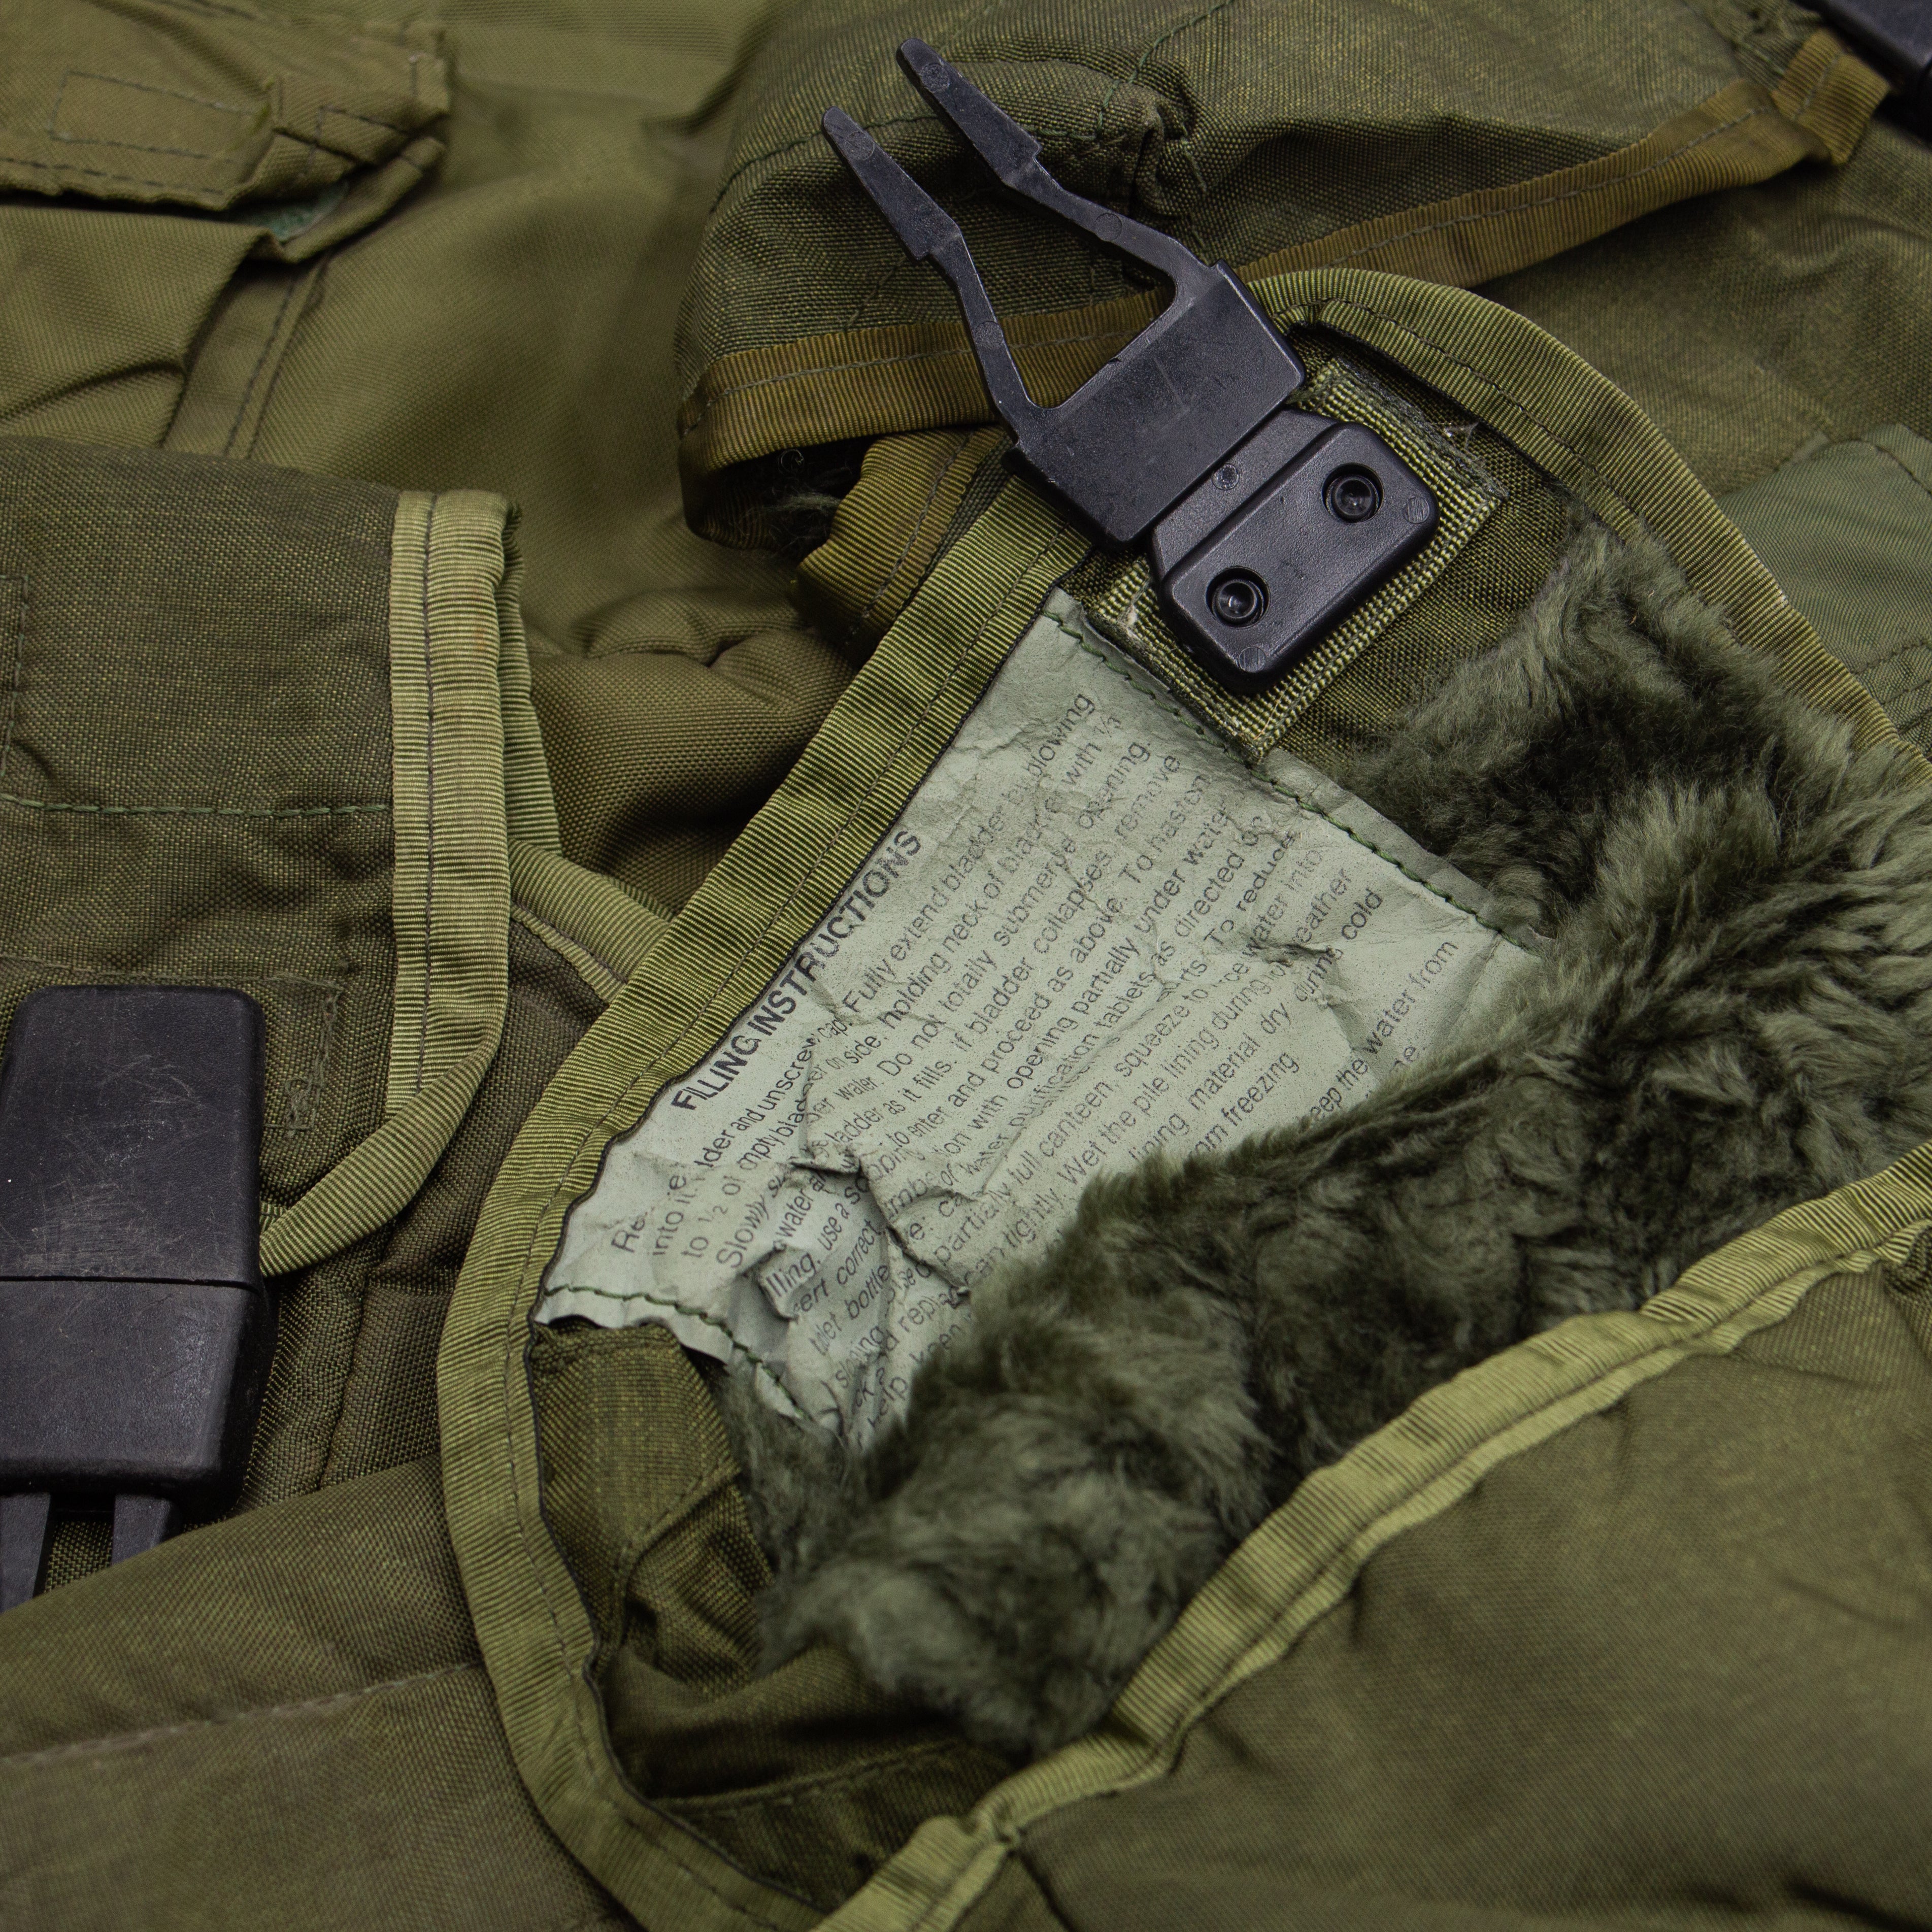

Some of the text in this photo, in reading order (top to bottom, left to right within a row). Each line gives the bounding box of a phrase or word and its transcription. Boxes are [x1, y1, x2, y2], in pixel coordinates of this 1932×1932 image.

[652, 1211, 684, 1256] into
[825, 1054, 846, 1070] on
[876, 952, 951, 1029] holding
[942, 900, 988, 953] neck
[976, 868, 1009, 899] of
[1061, 743, 1102, 785] with
[671, 1036, 762, 1110] FILLING
[748, 831, 921, 1036] INSTRUCTIONS
[716, 1195, 769, 1268] Slowly
[824, 1107, 883, 1142] ladder
[883, 1094, 906, 1119] as
[897, 1084, 922, 1101] it
[912, 1060, 957, 1089] fills.
[964, 957, 1034, 1035] bladder
[1114, 755, 1180, 839] remove
[730, 1108, 766, 1131] and
[842, 958, 893, 1013] Fully
[890, 886, 949, 961] extend
[1023, 693, 1096, 778] blowing
[777, 1188, 812, 1237] water
[907, 1106, 949, 1137] enter
[949, 1071, 986, 1108] and
[980, 992, 1052, 1074] proceed
[1047, 962, 1074, 992] as
[1118, 847, 1155, 890] To
[818, 1216, 841, 1251] use
[831, 1200, 853, 1219] a
[968, 1095, 1014, 1129] with
[1006, 1017, 1078, 1089] opening
[1071, 937, 1140, 1015] partially
[1134, 868, 1185, 933] under
[837, 1219, 882, 1283] correct
[957, 1134, 1009, 1175] water
[1093, 972, 1157, 1028] tablets
[1151, 941, 1176, 967] as
[1175, 849, 1245, 937] directed
[1008, 1150, 1040, 1182] full
[1114, 1006, 1190, 1077] squeeze
[1182, 984, 1209, 1002] to
[1284, 844, 1322, 890] into
[1056, 1141, 1106, 1184] Wet
[1098, 1111, 1136, 1144] the
[1132, 1077, 1170, 1117] pile
[1160, 1027, 1219, 1078] lining
[1212, 979, 1271, 1030] during
[1288, 868, 1351, 953] eather
[1188, 1033, 1260, 1110] material
[1260, 1003, 1291, 1034] dry
[1333, 887, 1383, 940] cold
[1310, 1087, 1342, 1122] eep
[1336, 1059, 1368, 1086] the
[1364, 989, 1416, 1054] water
[1409, 934, 1458, 989] from
[681, 1236, 709, 1258] to
[876, 1048, 913, 1077] Do
[910, 1014, 947, 1050] not
[938, 950, 997, 1012] totally
[844, 1265, 890, 1319] bottle
[1203, 912, 1235, 951] To
